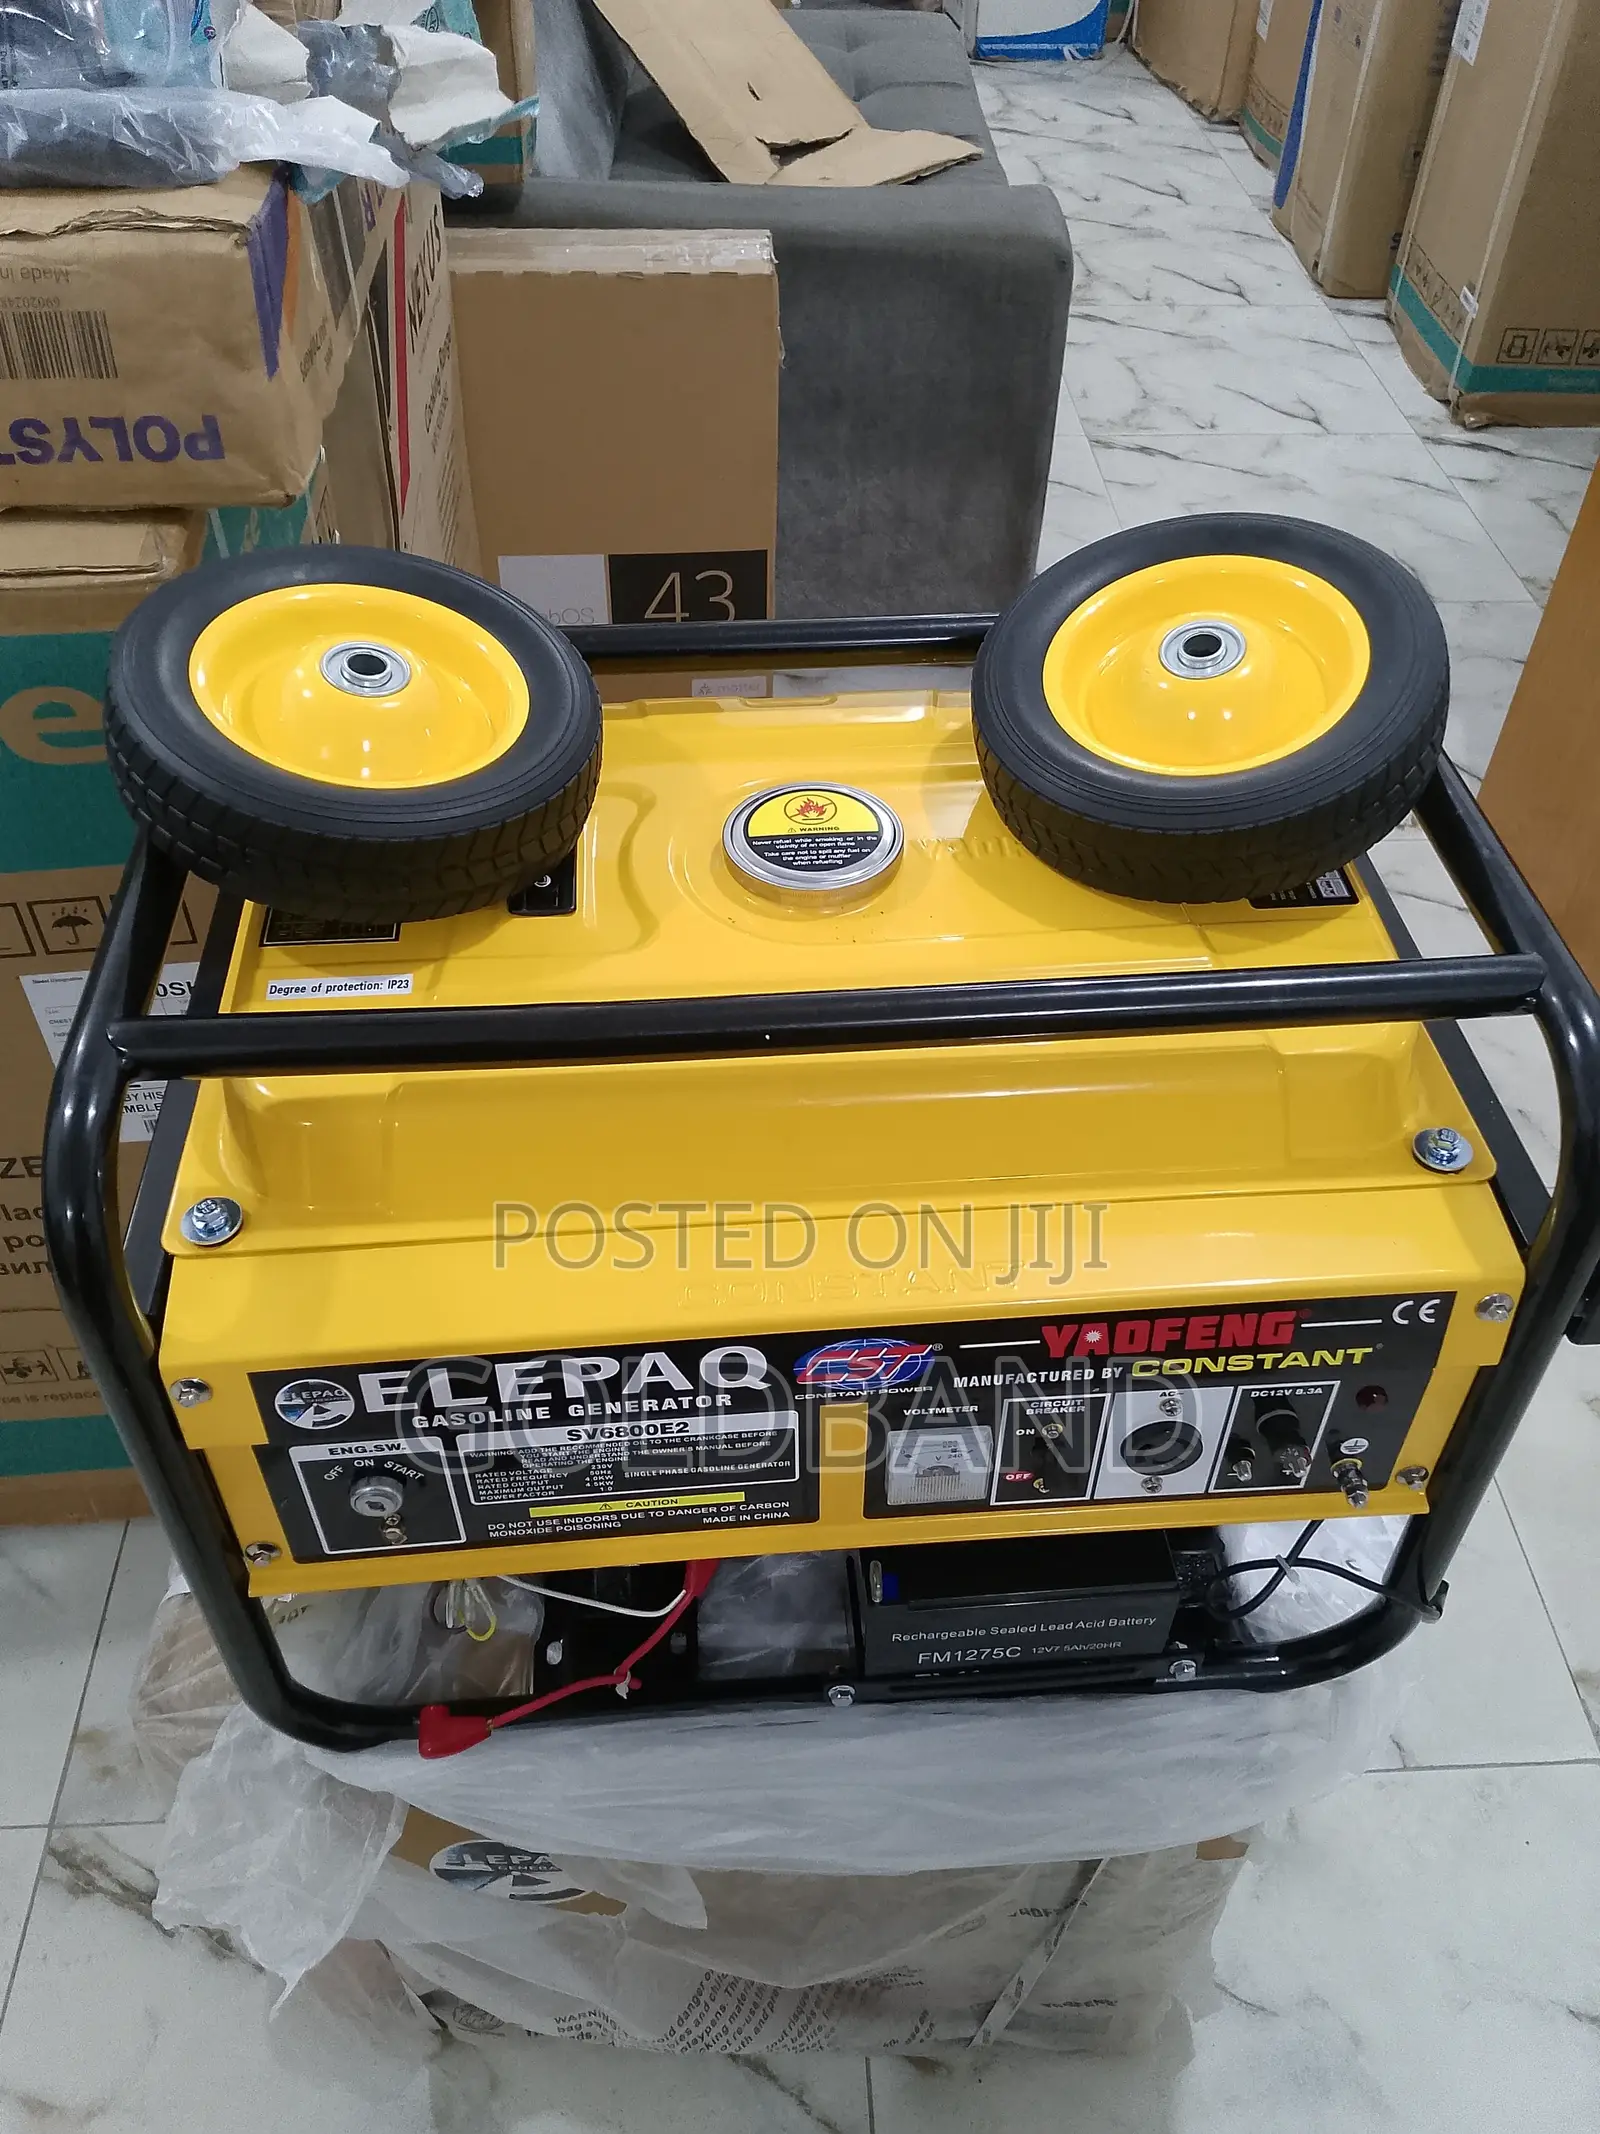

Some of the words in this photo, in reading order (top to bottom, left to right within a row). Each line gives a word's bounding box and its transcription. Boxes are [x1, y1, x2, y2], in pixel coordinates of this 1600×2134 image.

[644, 569, 736, 622] 43
[269, 984, 306, 996] Degree
[311, 982, 322, 993] of
[325, 980, 384, 994] protection:
[387, 979, 410, 990] IP23
[122, 1103, 162, 1114] MBLE
[1391, 1298, 1441, 1325] CE
[1041, 1310, 1297, 1358] YAOFENG
[796, 1343, 932, 1385] CST
[1131, 1347, 1373, 1378] CONSTANT
[357, 1345, 772, 1413] ELEPAQ
[953, 1368, 1095, 1389] MANUFACTURED
[1101, 1365, 1124, 1379] BY
[795, 1389, 875, 1400] CONSTANT
[878, 1385, 933, 1395] POWER
[1250, 1389, 1292, 1398] DC12V
[412, 1406, 551, 1428] GASOLINE
[567, 1393, 732, 1417] GENERATOR
[902, 1405, 979, 1416] VOLTMETER
[1025, 1405, 1086, 1416] BREAKER
[1029, 1400, 1084, 1408] CIRCUIT
[567, 1420, 690, 1442] SV6800E2
[1015, 1428, 1035, 1436] ON
[328, 1442, 407, 1456] ENG.SW.
[560, 1441, 631, 1451] RECOMMENDED
[683, 1433, 740, 1442] CRANKCASE
[741, 1430, 778, 1438] BEFORE
[542, 1450, 570, 1458] START
[570, 1451, 630, 1460] UNDERSTAND
[695, 1443, 733, 1451] MANUAL
[735, 1440, 772, 1448] BEFORE
[324, 1465, 345, 1481] OFF
[354, 1458, 375, 1468] ON
[384, 1460, 425, 1481] START
[522, 1460, 574, 1469] OPERATING
[624, 1470, 658, 1478] SINGLE
[659, 1467, 688, 1476] PHASE
[690, 1464, 736, 1473] GASOLINE
[737, 1460, 791, 1470] GENERATOR
[475, 1471, 506, 1479] RATED
[508, 1468, 553, 1476] VOLTAGE
[510, 1472, 569, 1482] FREQUENCY
[1005, 1472, 1032, 1481] OFF
[478, 1482, 509, 1490] RATED
[510, 1480, 550, 1488] OUTPUT
[479, 1487, 524, 1496] MAXIMUM
[526, 1484, 564, 1492] OUTPUT
[480, 1493, 516, 1501] POWER
[517, 1490, 555, 1498] FACTOR
[625, 1498, 679, 1509] CAUTION
[488, 1522, 506, 1531] DO
[507, 1520, 535, 1530] NOT
[536, 1518, 561, 1528] USE
[564, 1513, 618, 1525] INDOORS
[620, 1511, 646, 1520] DUE
[648, 1510, 665, 1518] TO
[667, 1505, 718, 1516] DANGER
[720, 1504, 738, 1512] OF
[738, 1500, 790, 1511] CARBON
[702, 1514, 737, 1524] MADE
[738, 1513, 751, 1521] IN
[754, 1510, 790, 1521] CHINA
[488, 1525, 553, 1538] MONOXIDE
[555, 1521, 622, 1534] POISONING
[892, 1628, 987, 1643] Rechargeable
[990, 1623, 1037, 1636] Sealed
[1040, 1622, 1073, 1632] Lead
[1074, 1618, 1105, 1630] Acid
[1108, 1616, 1157, 1628] Battery
[917, 1646, 1022, 1665] FM1275C
[676, 1981, 706, 2028] danger
[693, 2000, 710, 2029] and
[753, 2008, 770, 2036] and
